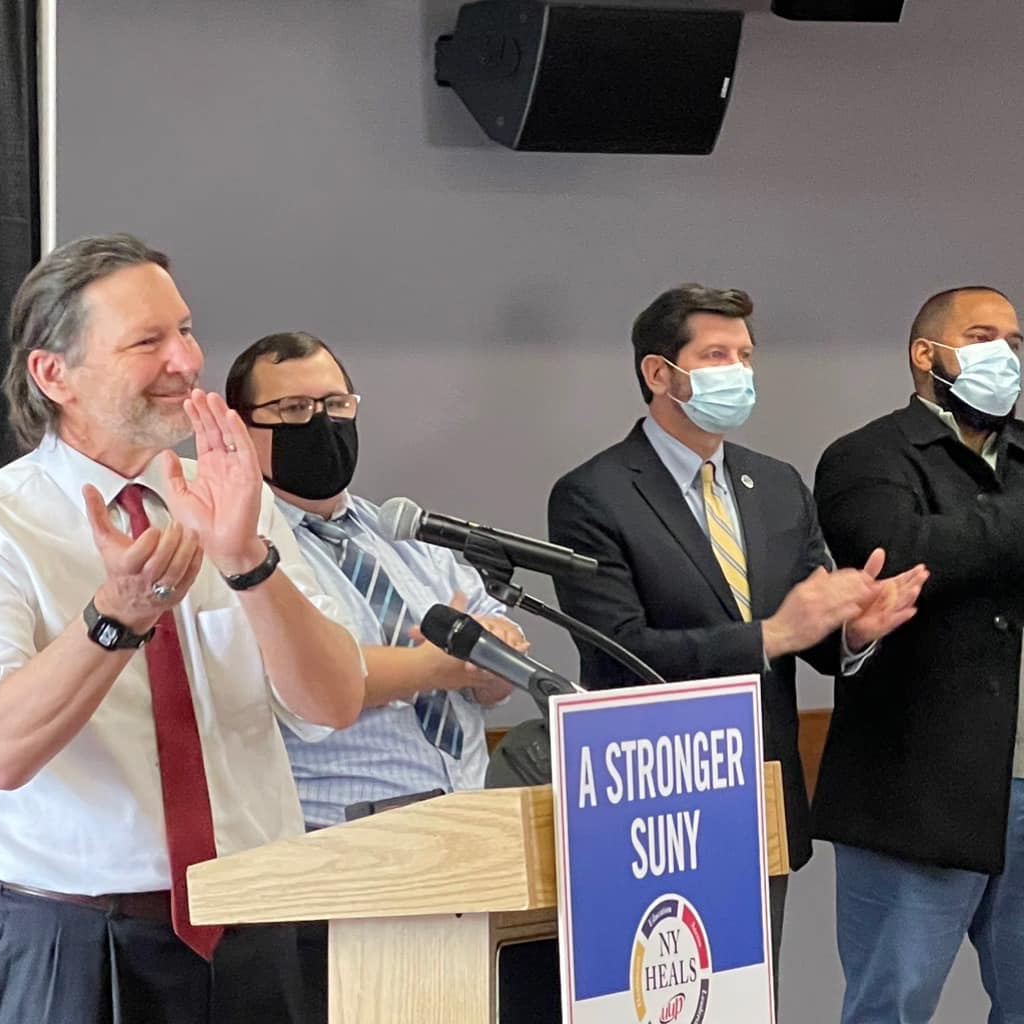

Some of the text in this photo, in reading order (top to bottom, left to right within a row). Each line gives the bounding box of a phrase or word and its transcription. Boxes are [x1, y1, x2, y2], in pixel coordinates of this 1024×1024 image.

[578, 727, 745, 808] A STRONGER
[630, 809, 701, 880] SUNY
[658, 929, 680, 957] NY
[645, 957, 697, 992] HEALS
